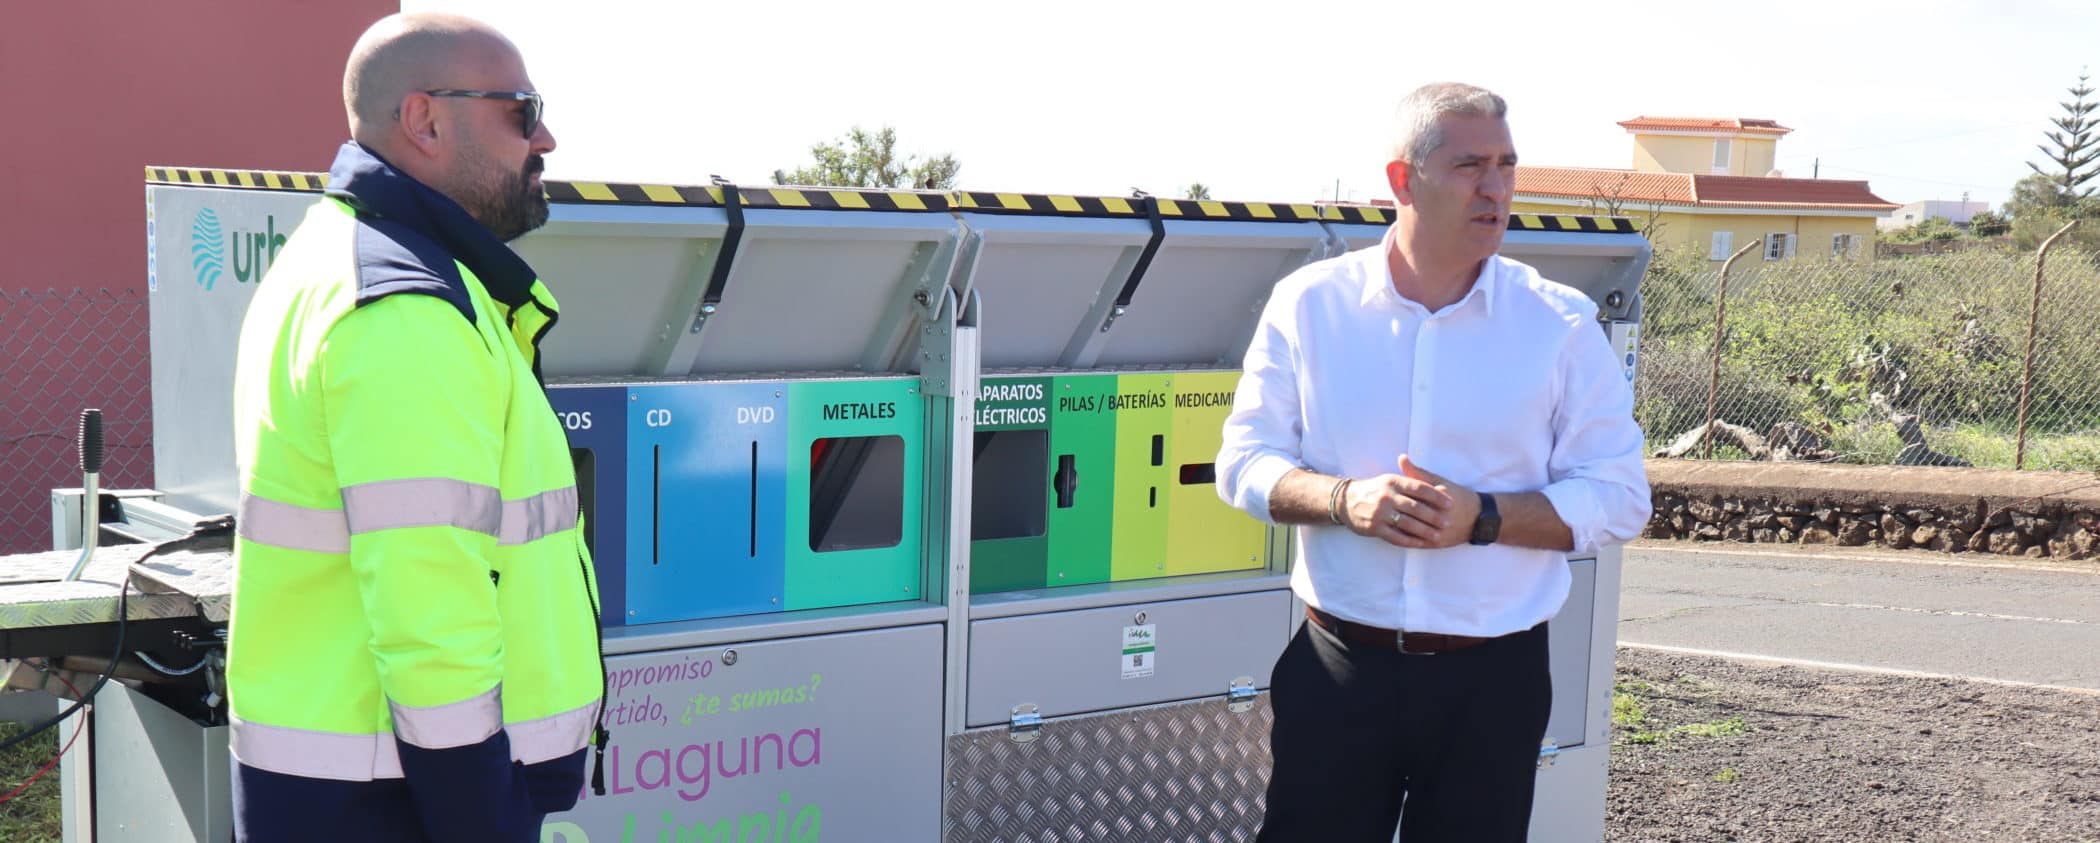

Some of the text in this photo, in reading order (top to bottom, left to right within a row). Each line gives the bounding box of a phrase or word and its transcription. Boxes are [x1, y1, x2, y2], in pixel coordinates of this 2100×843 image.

[823, 402, 896, 421] METALES
[1060, 390, 1166, 413] PILAS / BATERÍAS
[646, 409, 672, 427] CD
[737, 406, 775, 424] DVD
[974, 405, 1046, 425] LÉCTRICOS
[681, 693, 721, 725] ¿te
[728, 673, 822, 713] sumas?
[612, 727, 821, 801] Laguna
